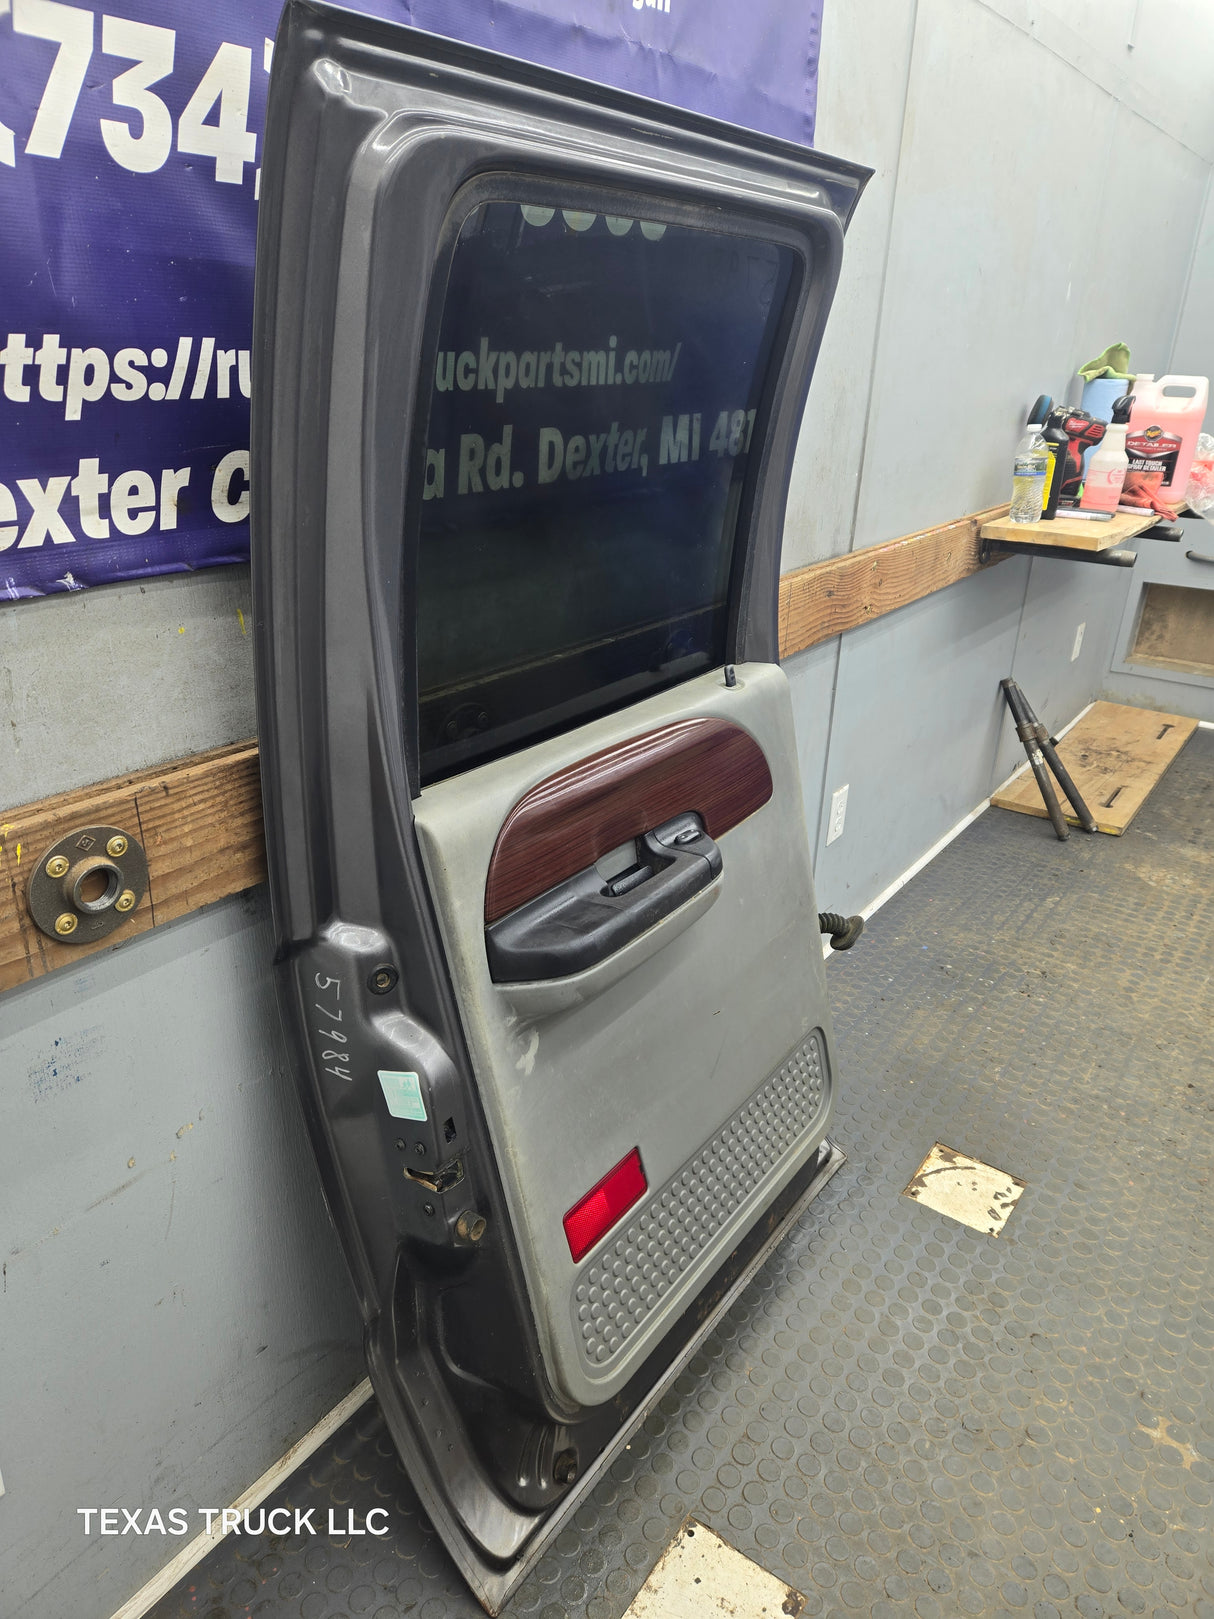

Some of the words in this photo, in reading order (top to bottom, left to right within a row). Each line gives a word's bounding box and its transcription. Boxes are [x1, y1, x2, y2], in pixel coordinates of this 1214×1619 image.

[0, 0, 274, 201] 734
[457, 424, 525, 495] Rd.
[537, 421, 649, 484] Dexter,
[659, 412, 702, 465] MI
[315, 972, 352, 1081] 57984
